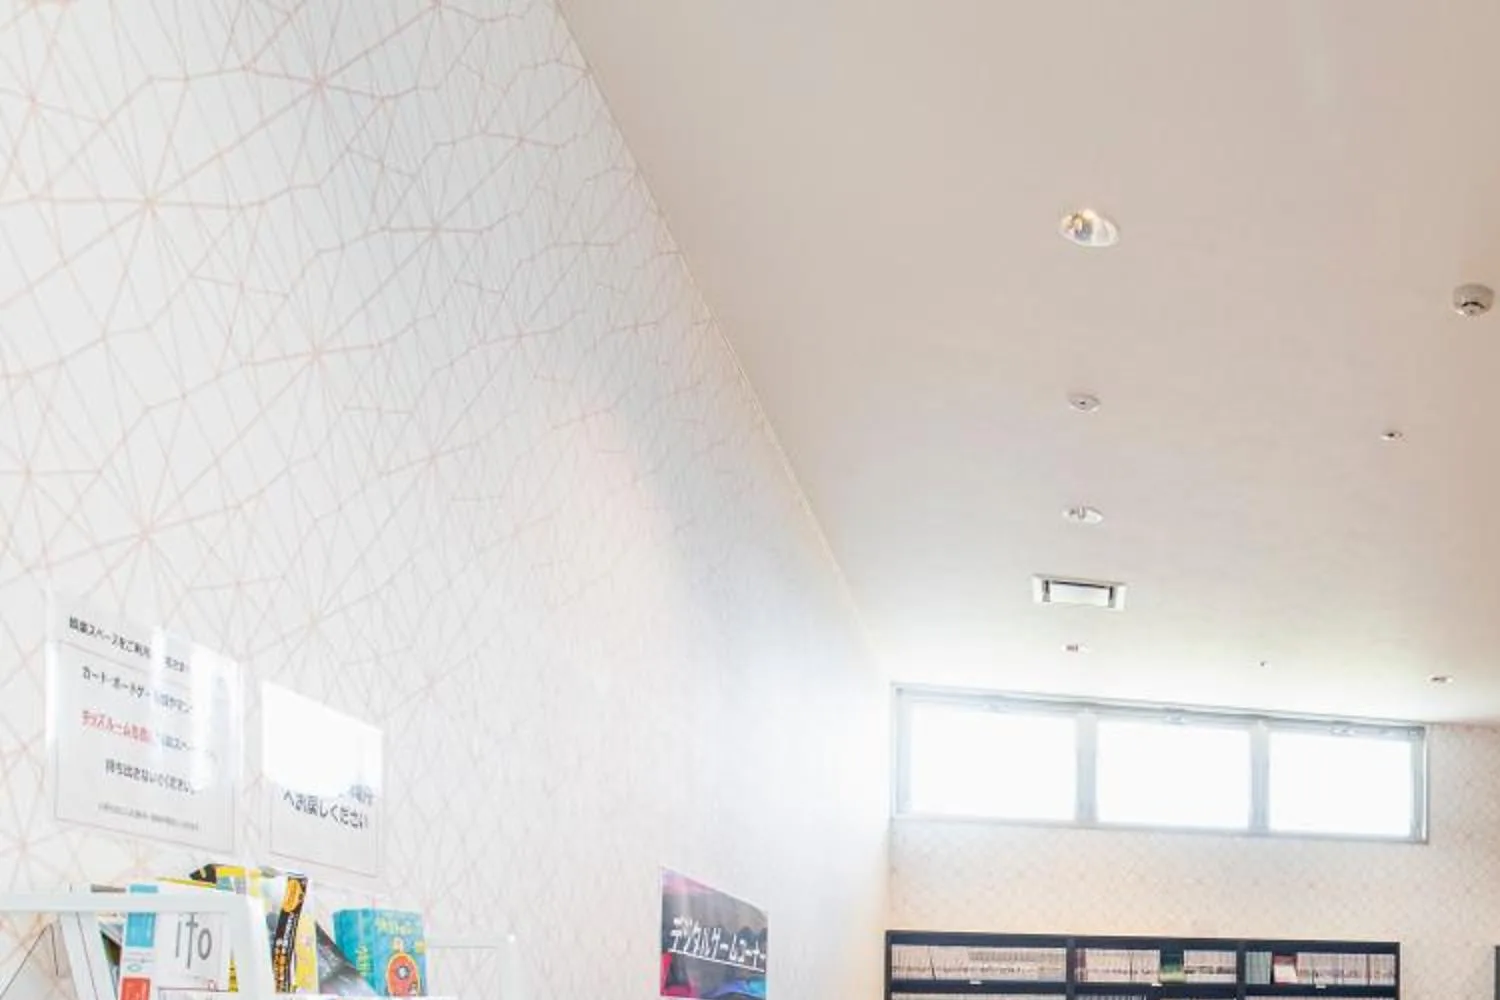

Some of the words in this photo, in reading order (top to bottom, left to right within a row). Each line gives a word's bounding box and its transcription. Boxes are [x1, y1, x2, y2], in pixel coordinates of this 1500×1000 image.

[669, 916, 767, 970] デジタルゲームコーナー
